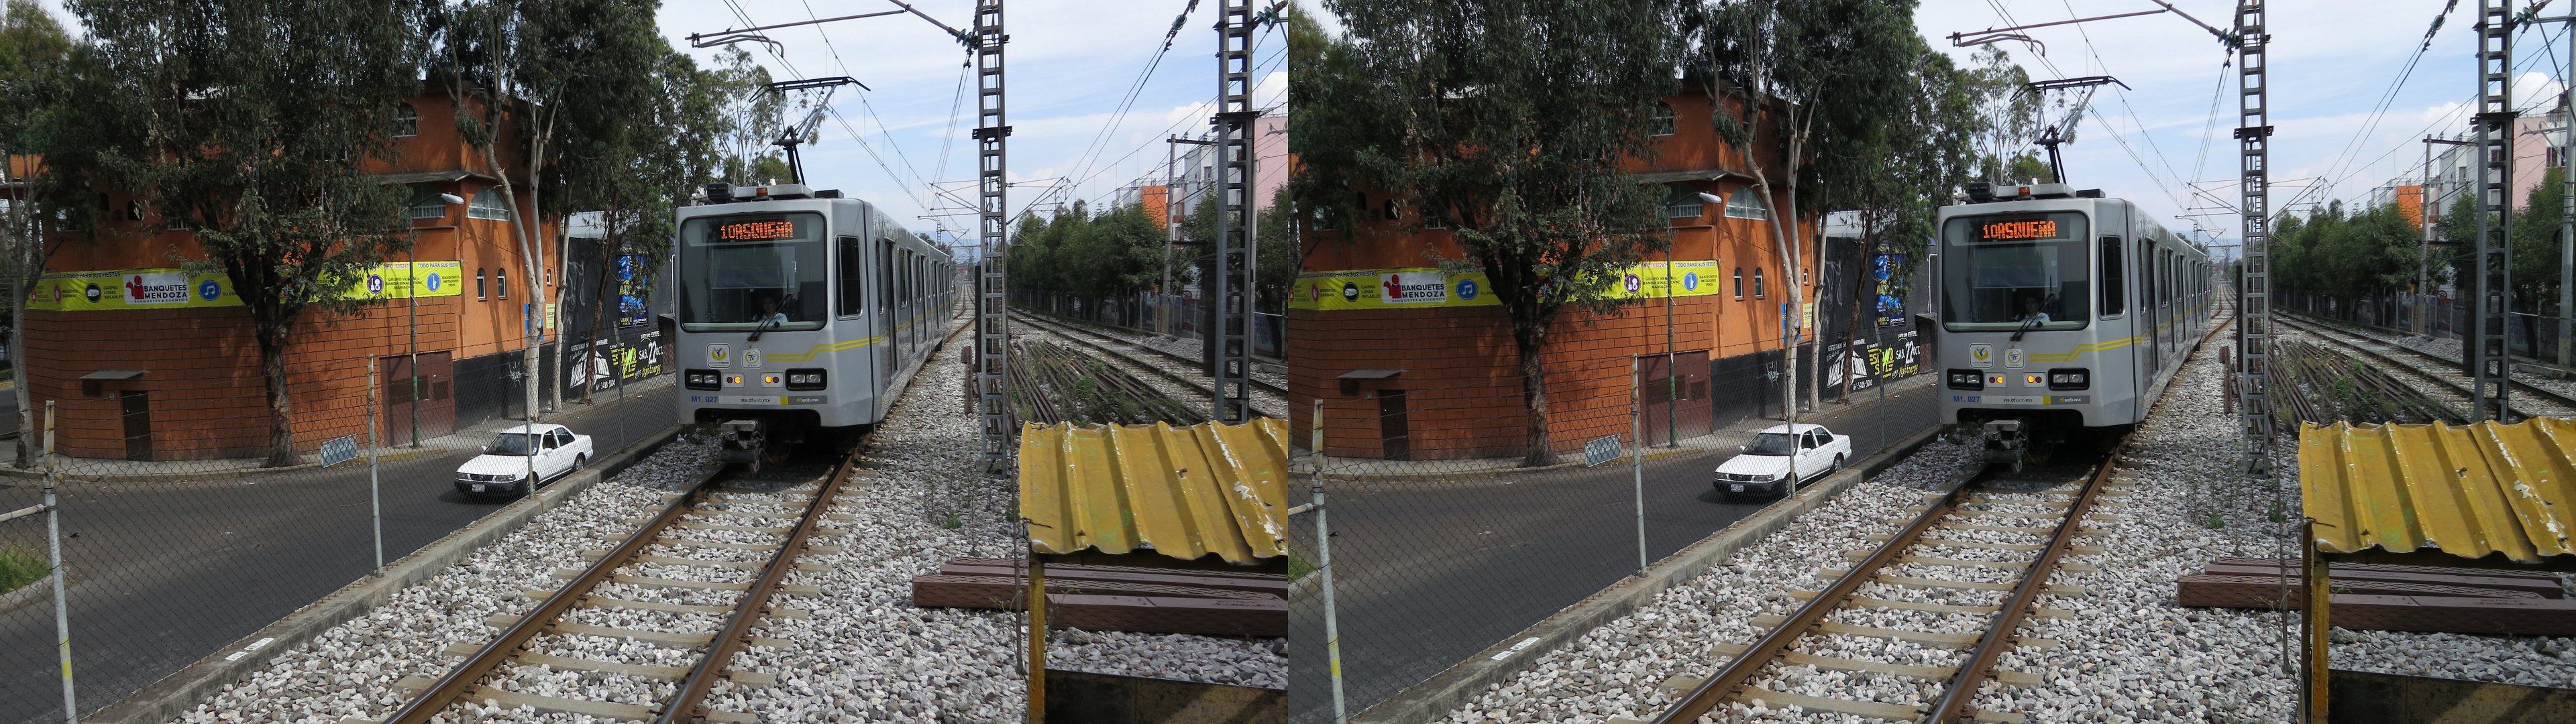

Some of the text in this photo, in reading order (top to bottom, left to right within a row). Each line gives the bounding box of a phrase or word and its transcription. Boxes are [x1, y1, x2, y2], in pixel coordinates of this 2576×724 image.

[144, 284, 187, 292] BANQUETES
[639, 349, 649, 360] SAB.
[648, 341, 657, 365] 22
[1896, 349, 1905, 360] SAB.
[1905, 341, 1915, 364] 22
